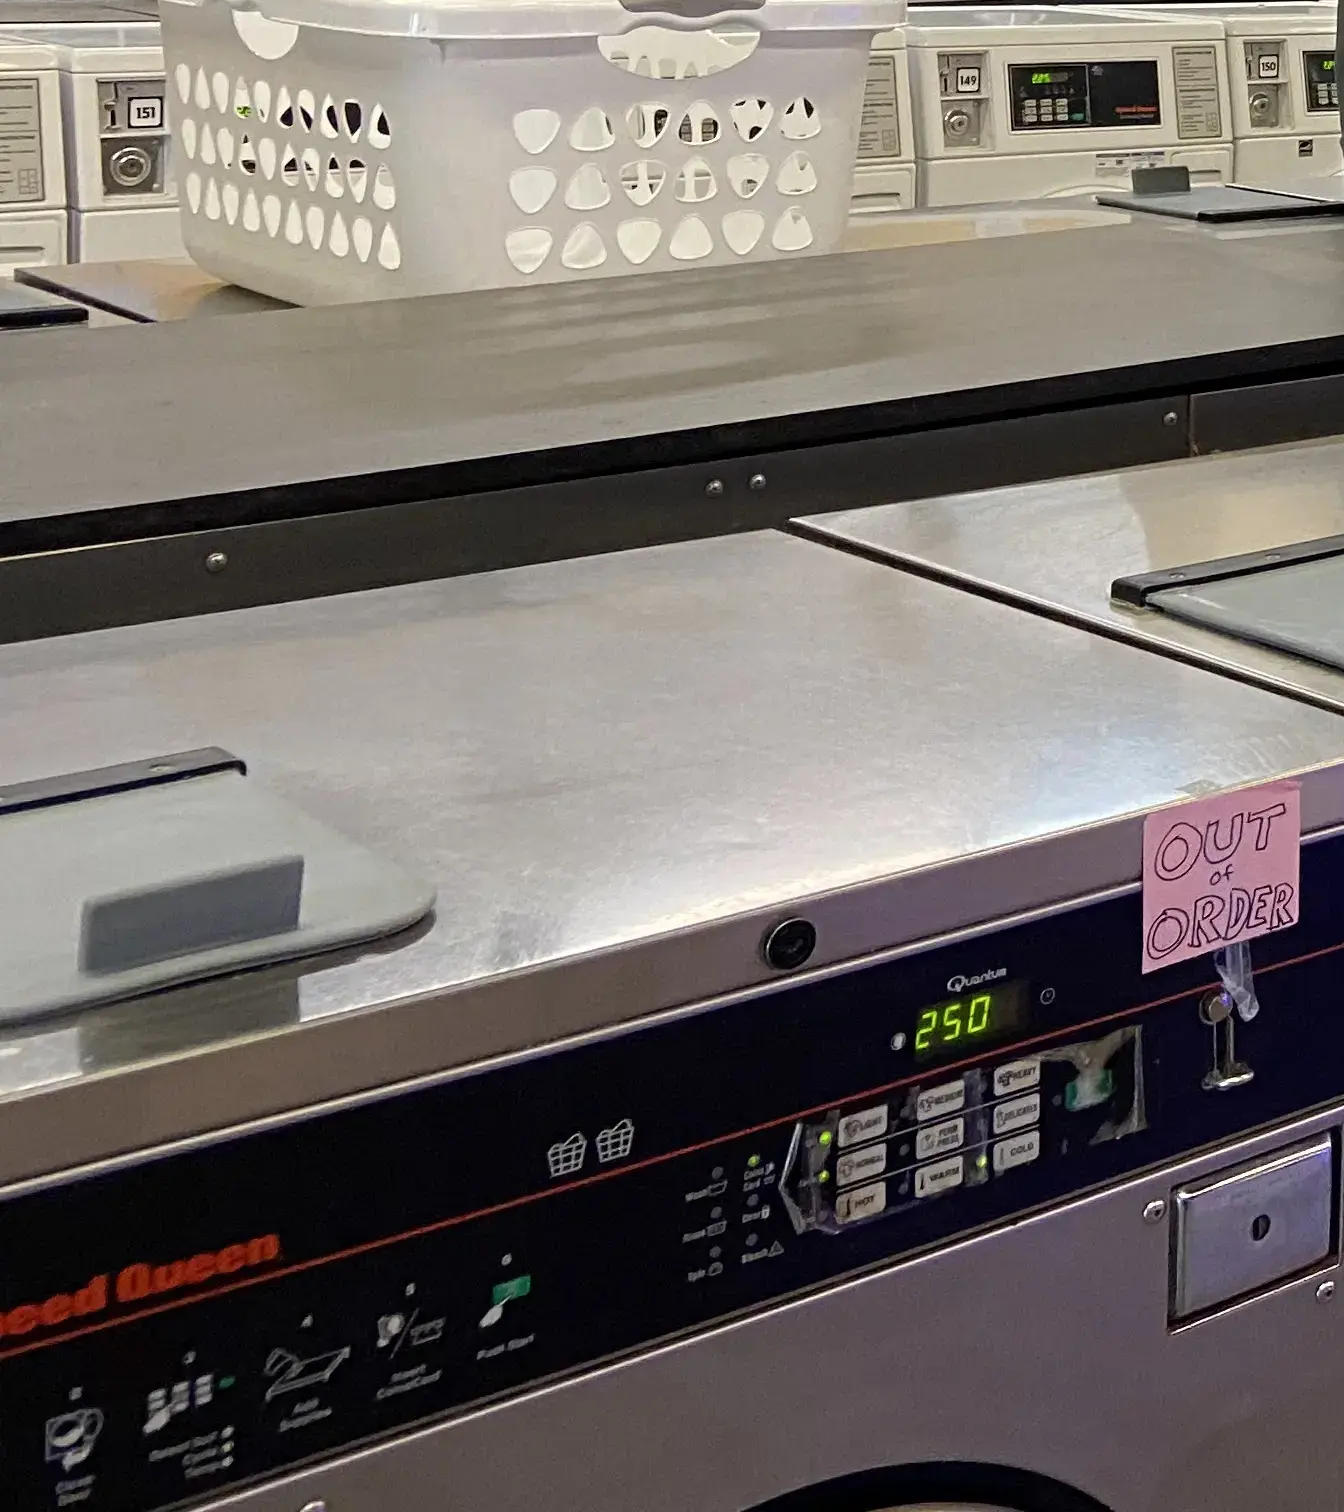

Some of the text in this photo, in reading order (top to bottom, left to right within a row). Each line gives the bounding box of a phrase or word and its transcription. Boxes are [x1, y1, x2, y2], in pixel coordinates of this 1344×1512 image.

[1261, 61, 1276, 72] 150
[959, 75, 977, 86] 149
[136, 106, 156, 119] 151
[1153, 803, 1287, 881] OUT
[1209, 865, 1234, 885] of
[1146, 883, 1294, 961] ORDER
[947, 968, 1007, 992] Quantum
[914, 995, 992, 1051] 250
[1010, 1142, 1035, 1157] COLD
[854, 1193, 875, 1209] HOT
[0, 1233, 280, 1336] eed Queen
